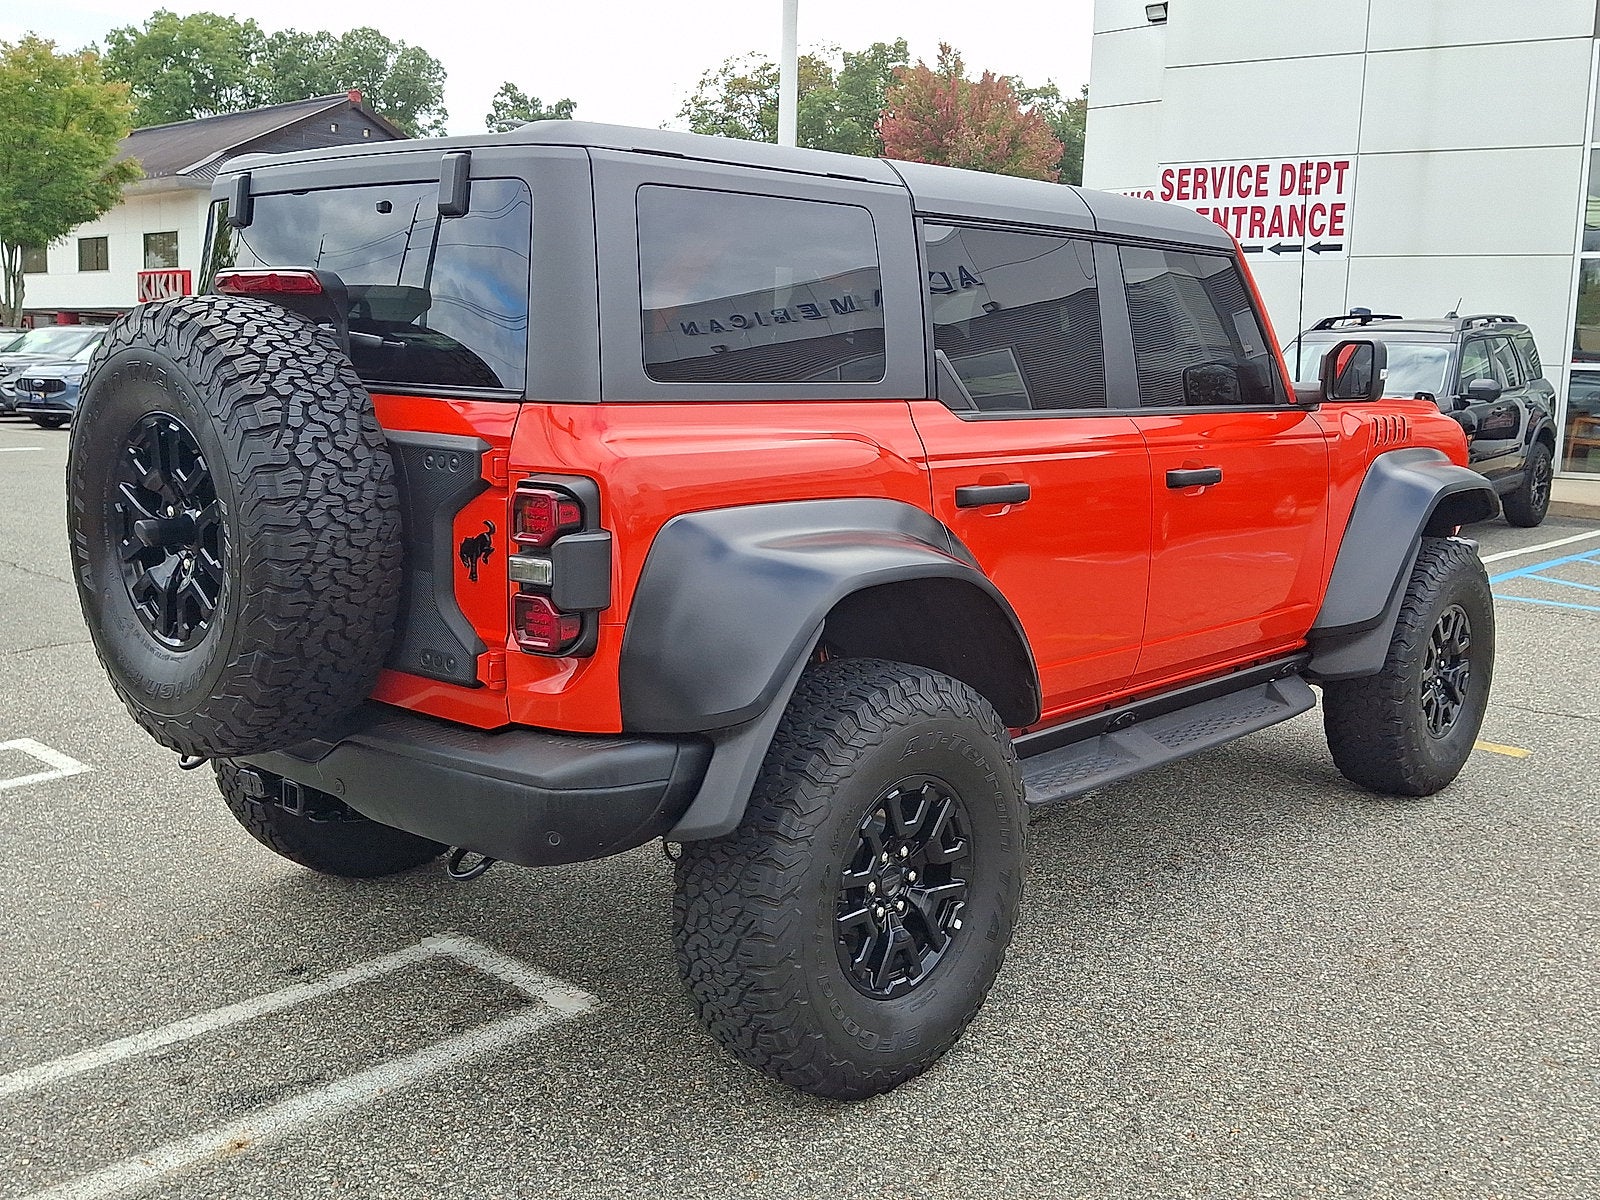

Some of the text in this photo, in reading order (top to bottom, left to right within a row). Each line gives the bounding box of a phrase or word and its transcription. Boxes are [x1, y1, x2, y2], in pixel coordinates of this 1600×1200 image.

[1161, 160, 1350, 202] SERVICE DEPT
[1196, 202, 1346, 239] NTRANCE
[138, 272, 183, 301] KIKU
